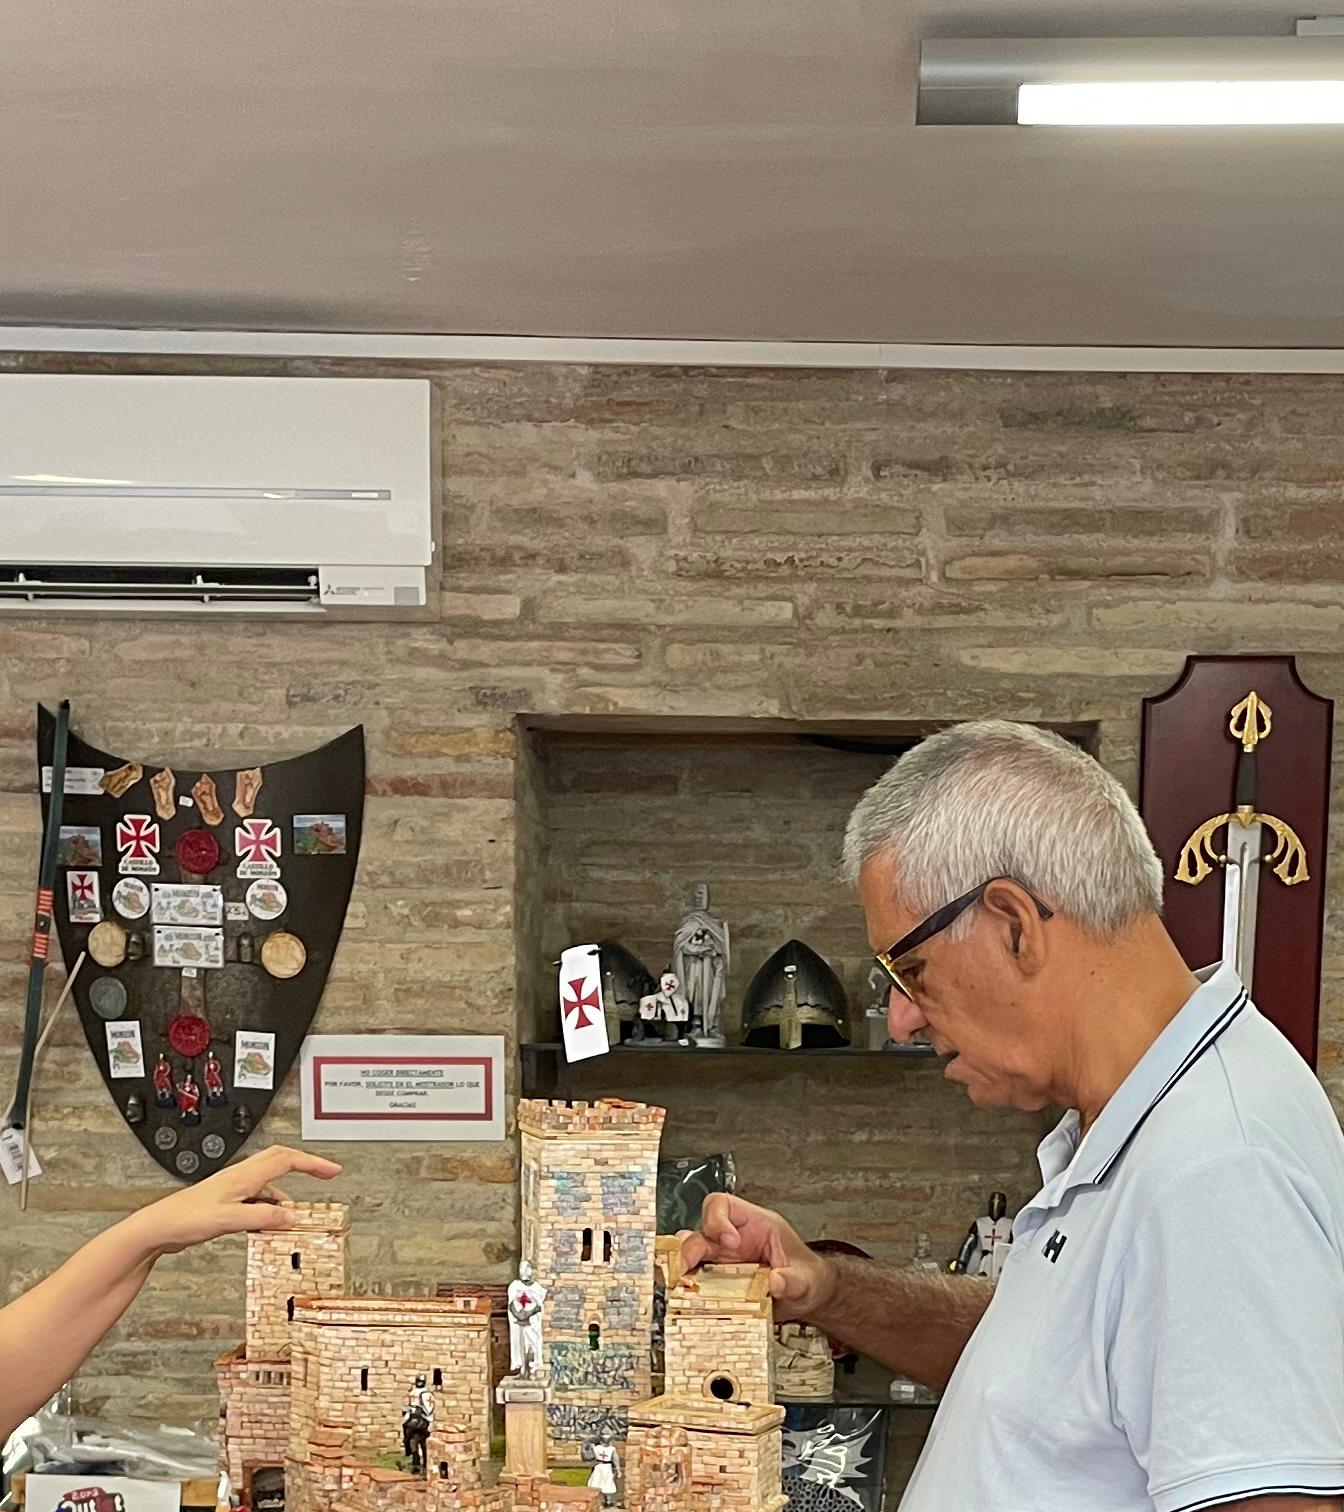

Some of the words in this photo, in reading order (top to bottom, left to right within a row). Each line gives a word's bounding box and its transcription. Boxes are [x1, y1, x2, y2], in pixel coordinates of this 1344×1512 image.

[360, 1069, 370, 1077] NO
[372, 1069, 394, 1077] COGER
[395, 1069, 444, 1077] DIRECTAMENTE
[365, 1081, 394, 1089] SOLICITE
[395, 1081, 404, 1089] EN
[406, 1081, 414, 1089] EL
[415, 1081, 454, 1089] MOSTRADOR
[389, 1101, 417, 1109] GRACIAS
